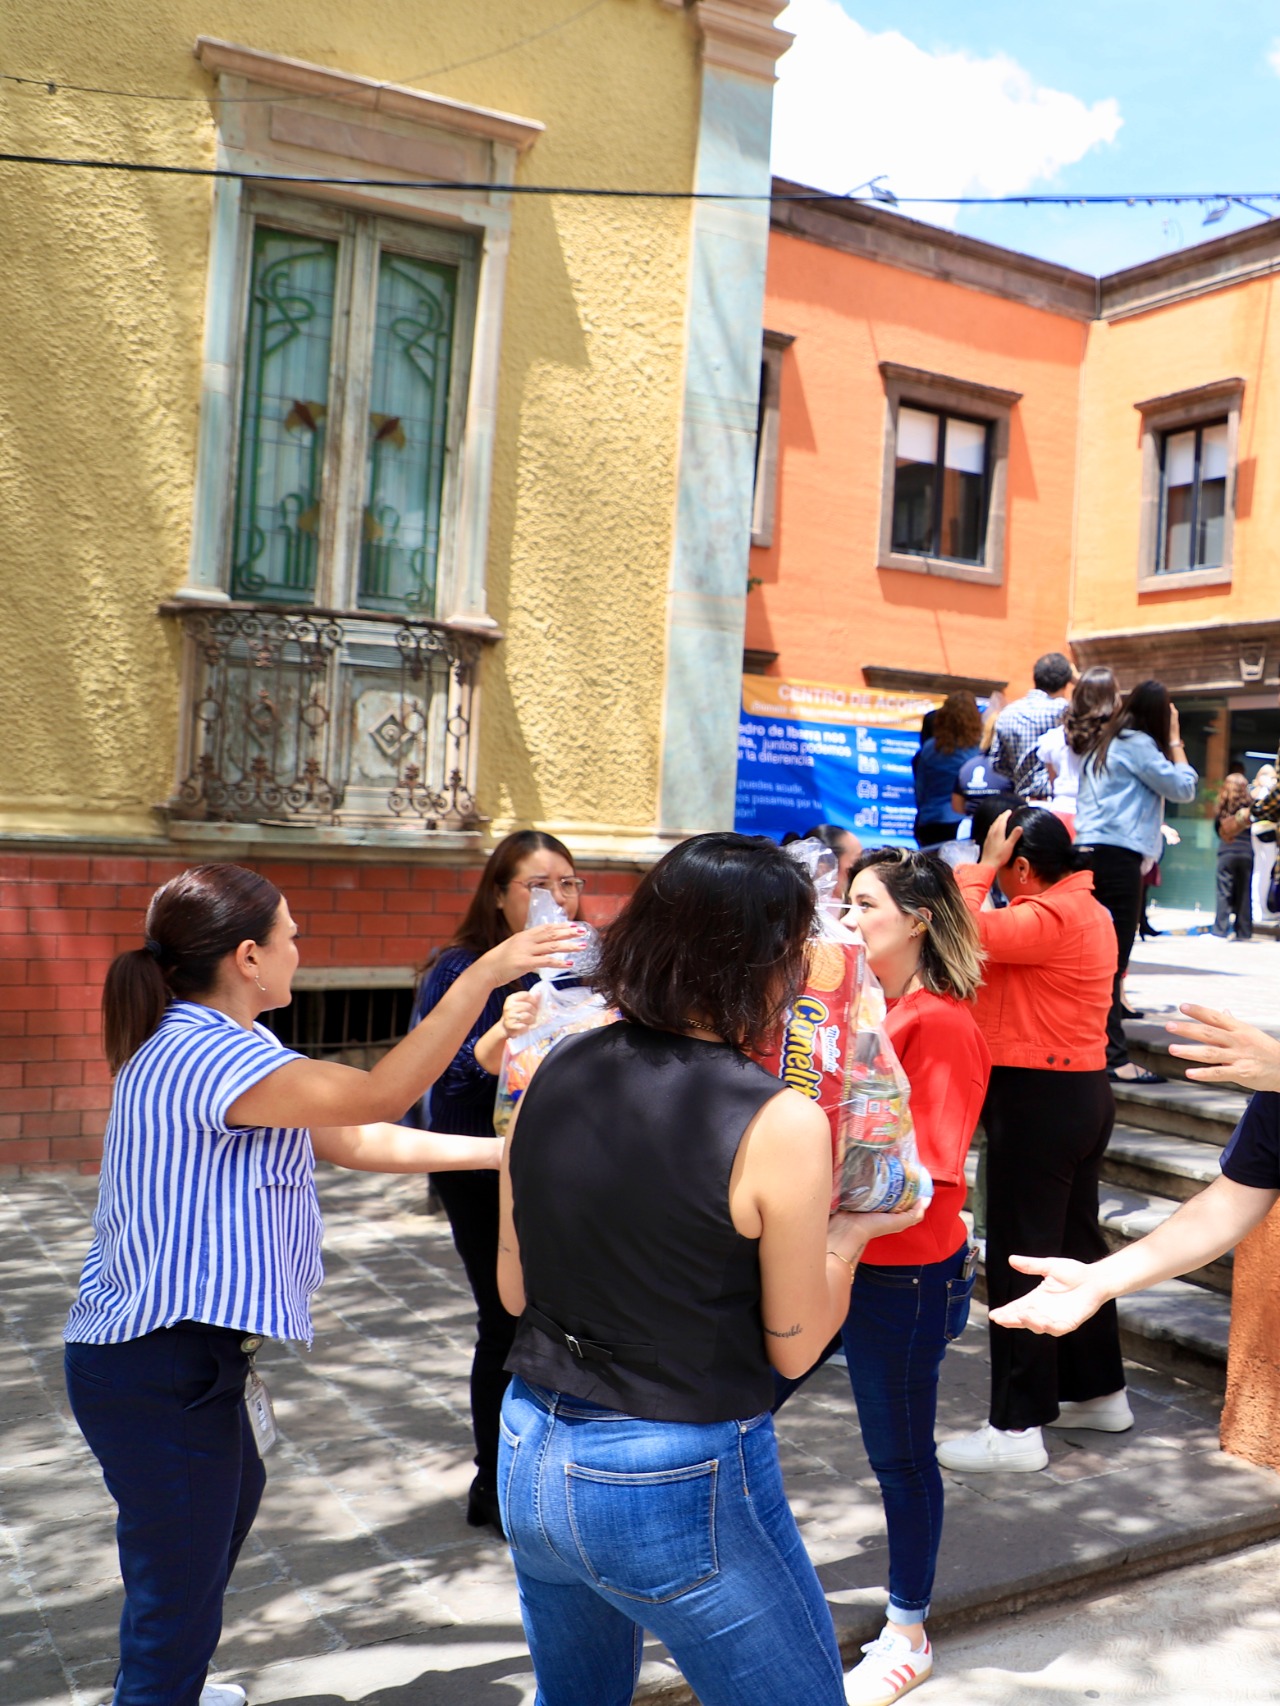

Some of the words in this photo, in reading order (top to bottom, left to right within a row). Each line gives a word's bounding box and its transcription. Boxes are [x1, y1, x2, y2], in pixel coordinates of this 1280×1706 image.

[778, 684, 846, 707] CENTRO
[850, 691, 871, 710] DE
[768, 724, 784, 738] de
[823, 731, 846, 744] nos
[762, 737, 798, 753] juntos
[800, 741, 852, 757] podemos
[745, 749, 757, 762] la
[758, 751, 815, 767] diferencia
[752, 794, 795, 807] pasamos
[796, 798, 811, 810] por
